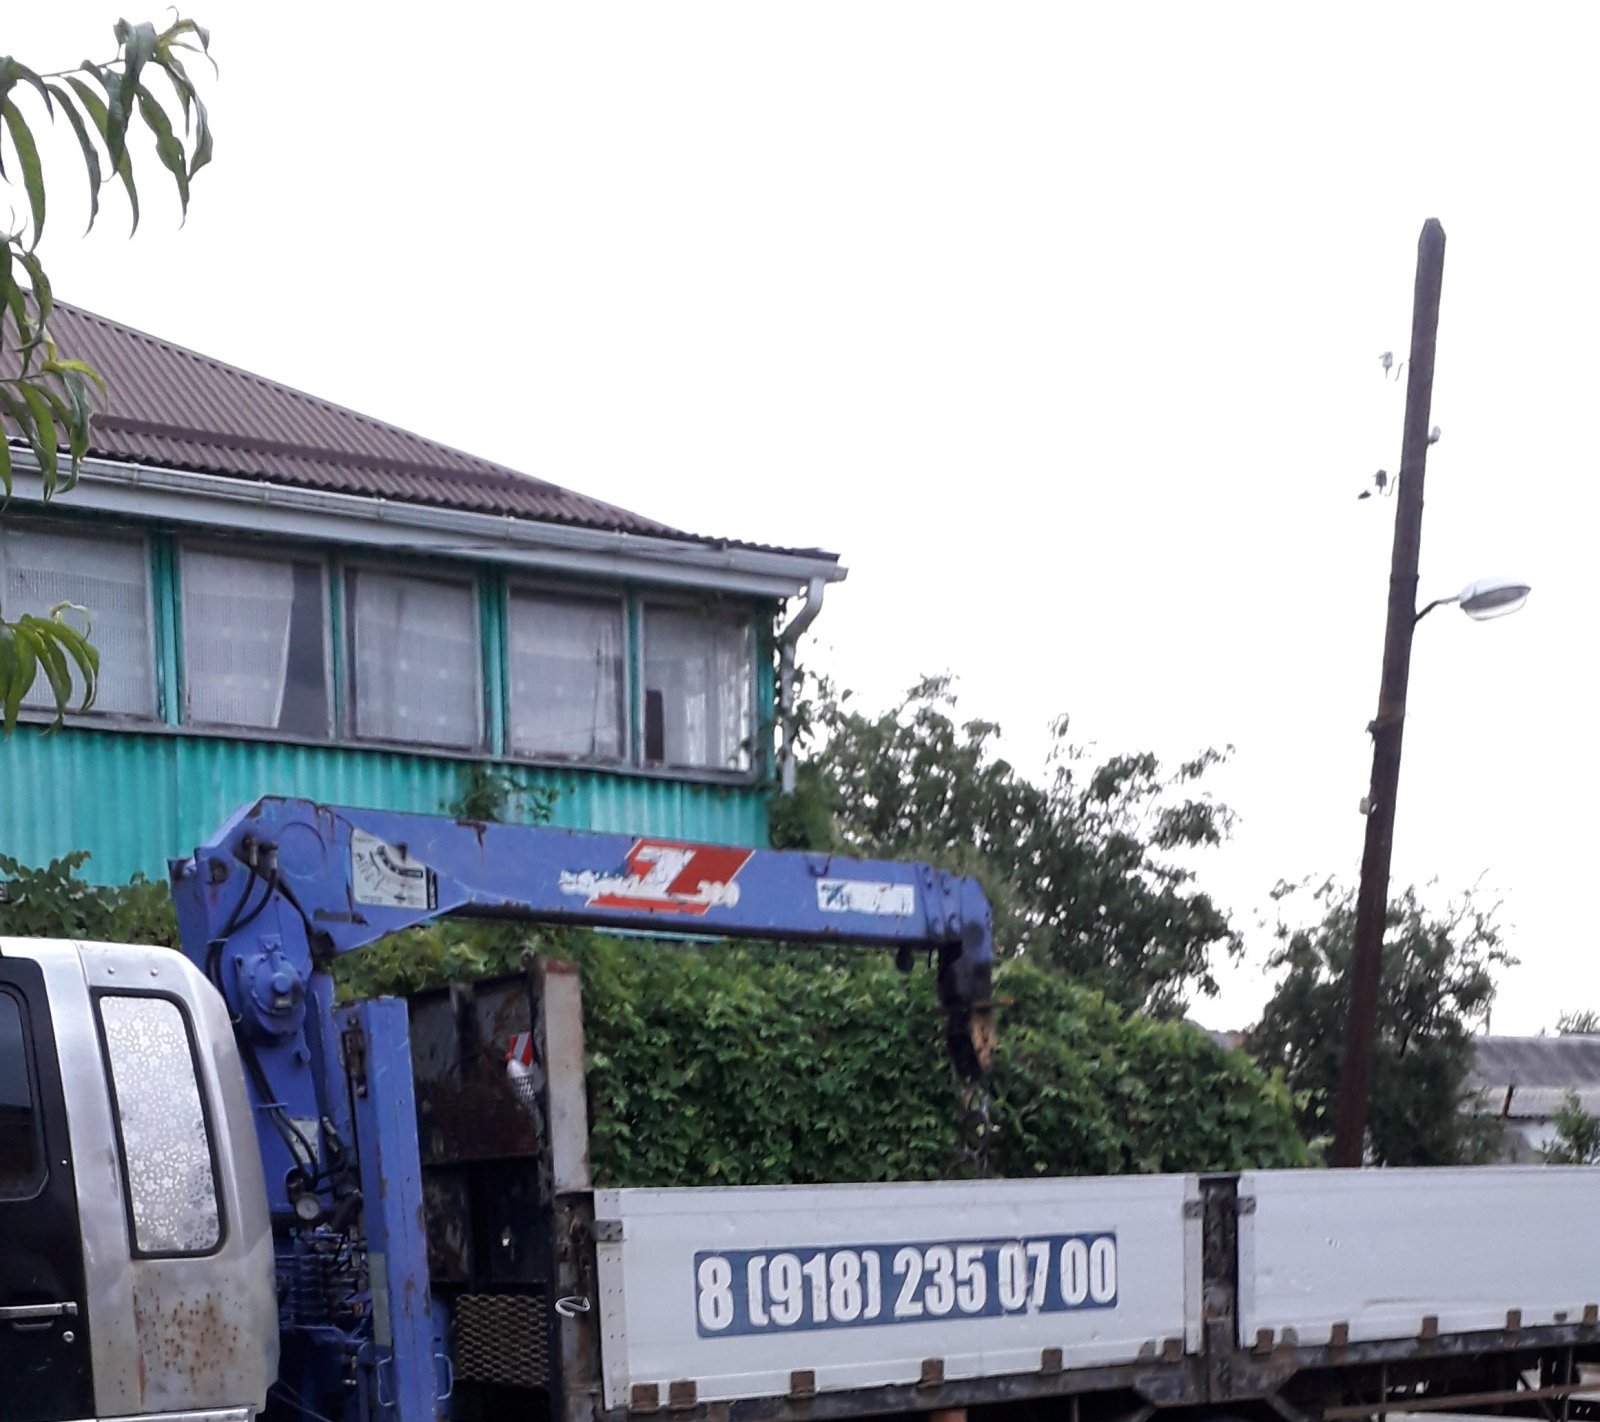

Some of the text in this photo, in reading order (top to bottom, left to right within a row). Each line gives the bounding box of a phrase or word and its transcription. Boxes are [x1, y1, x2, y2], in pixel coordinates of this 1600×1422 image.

[698, 1237, 1117, 1330] 8 (918) 235 07 00
